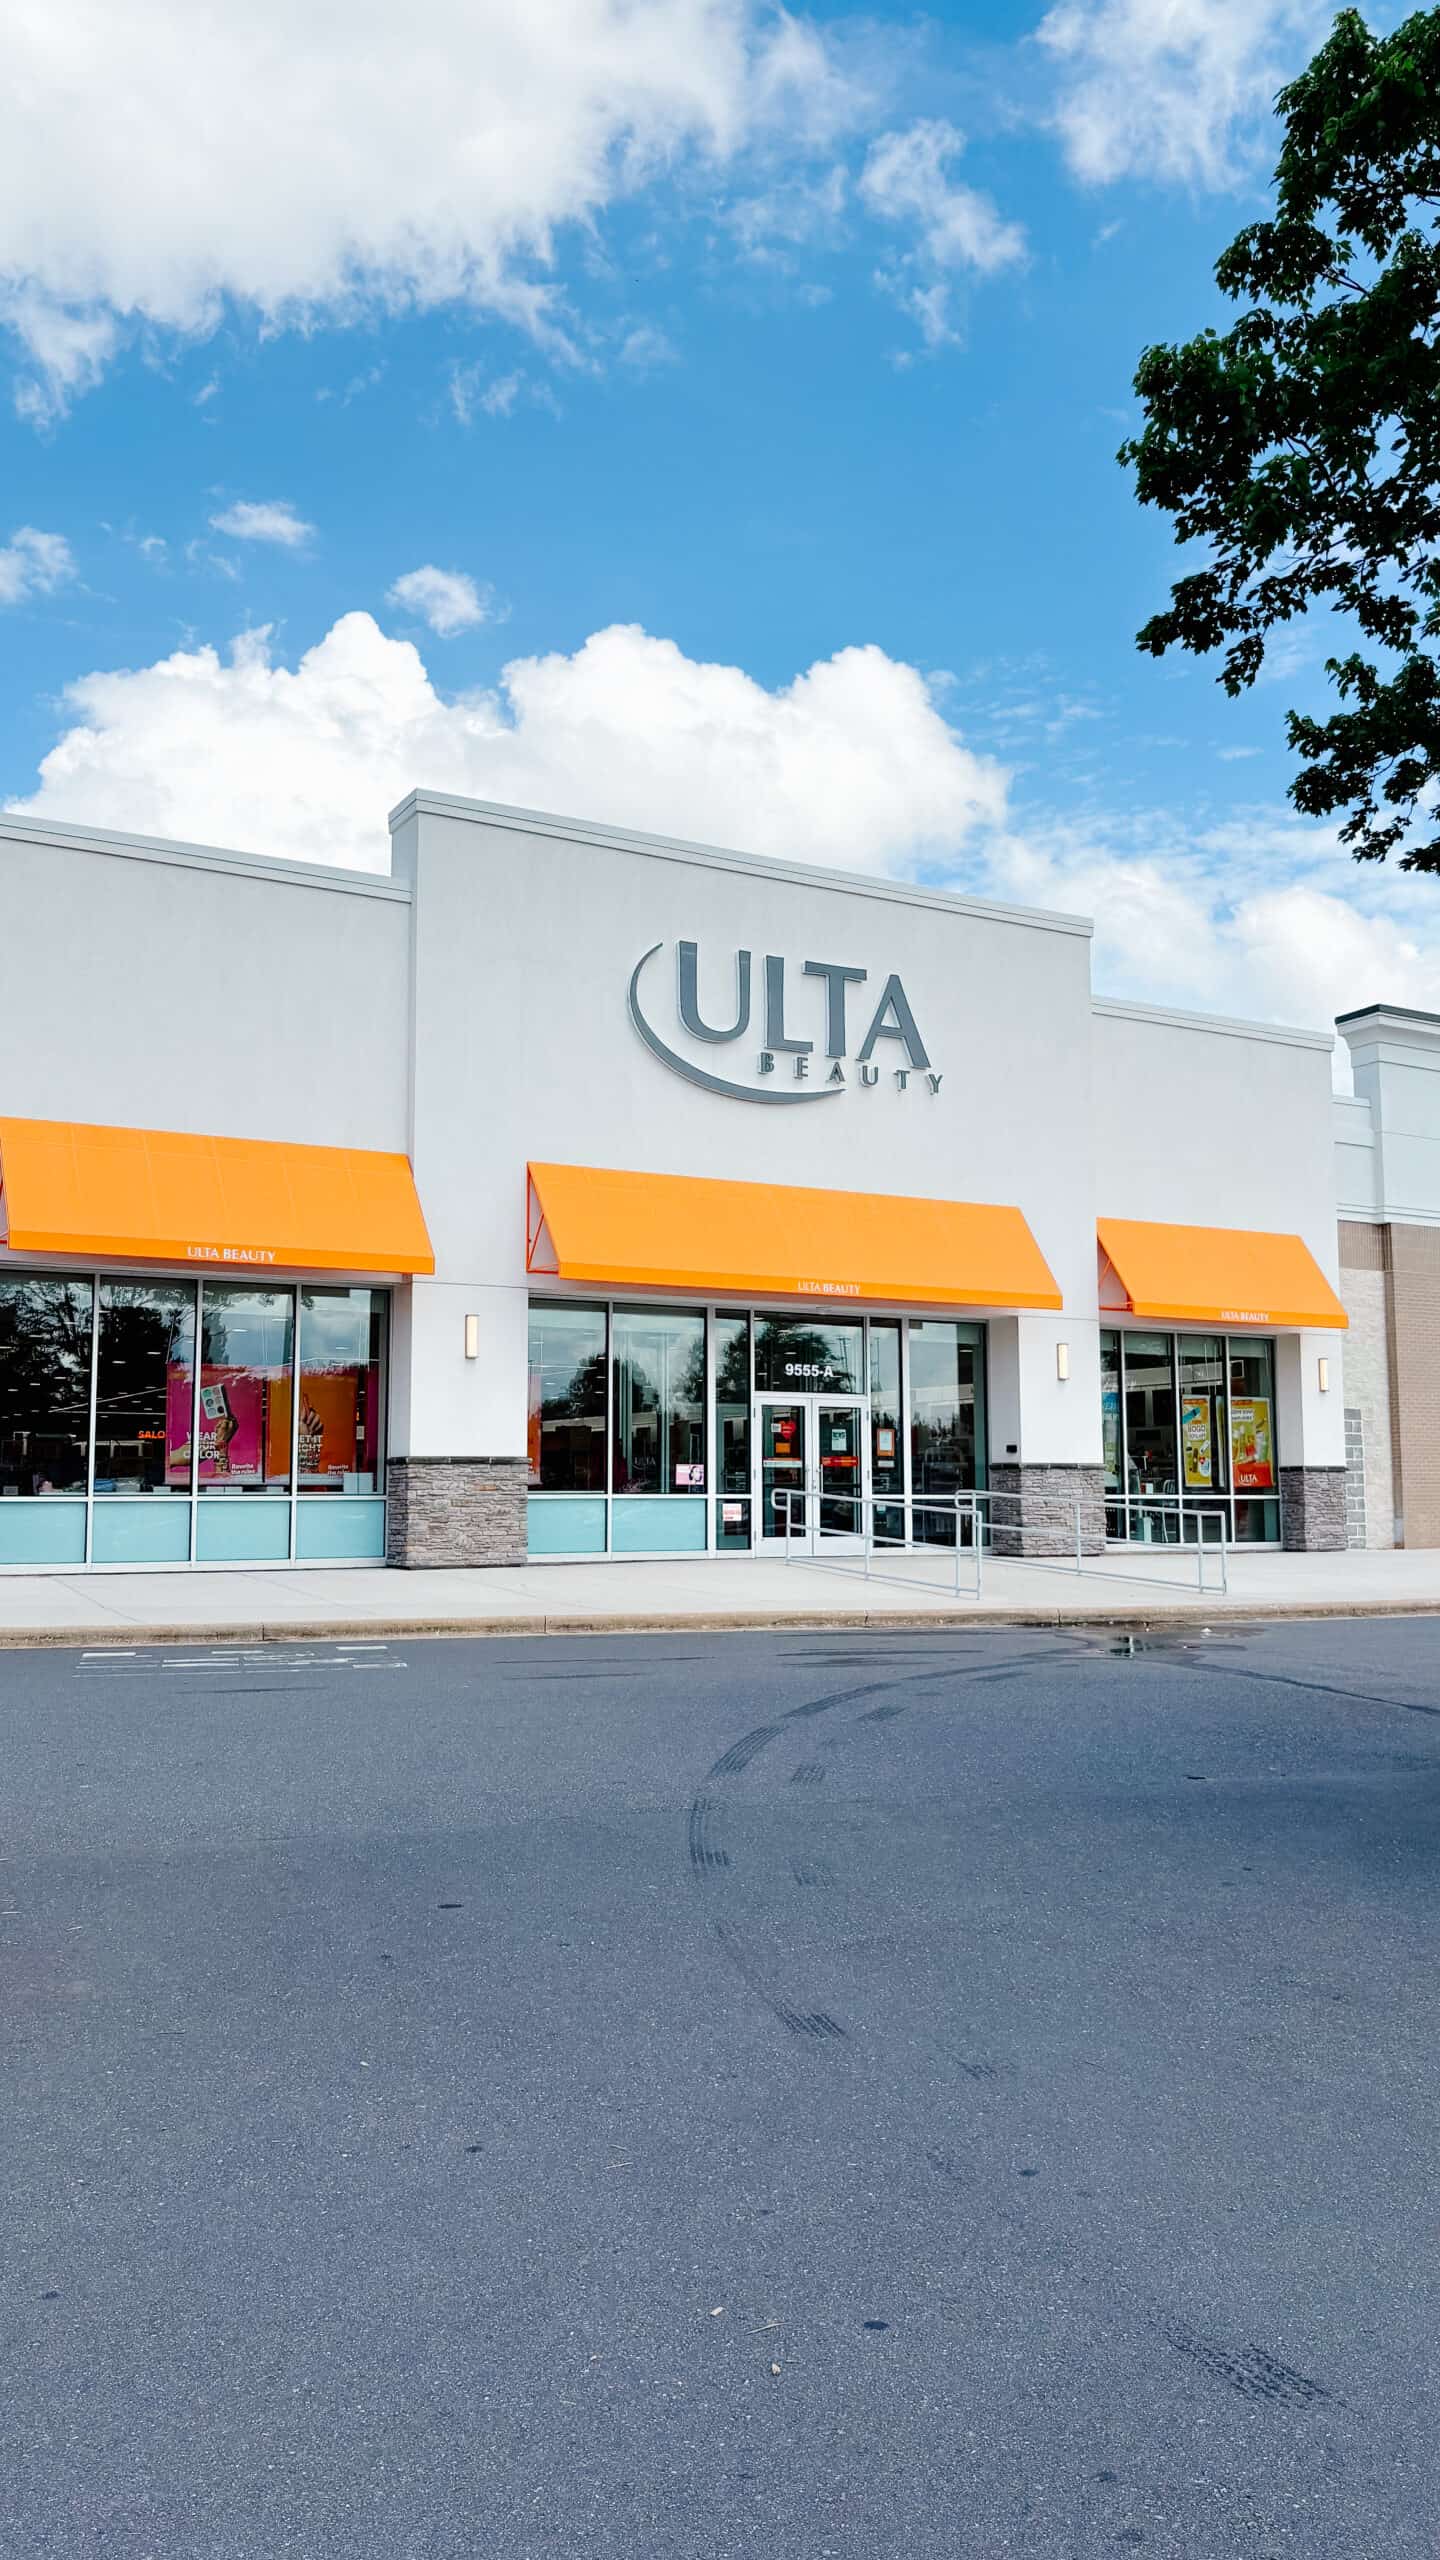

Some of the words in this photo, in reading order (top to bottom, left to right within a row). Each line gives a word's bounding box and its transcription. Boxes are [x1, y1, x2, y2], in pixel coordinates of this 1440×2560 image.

[677, 940, 932, 1069] ULTA
[758, 1052, 943, 1096] BEAUTY
[187, 1246, 219, 1258] ULTA
[223, 1248, 276, 1263] BEAUTY
[798, 1280, 820, 1292] ULTA
[823, 1282, 860, 1295] BEAUTY
[785, 1363, 833, 1377] 9555-A
[138, 1431, 166, 1439] SALO
[184, 1450, 220, 1459] CLOR
[298, 1444, 323, 1453] IGHT
